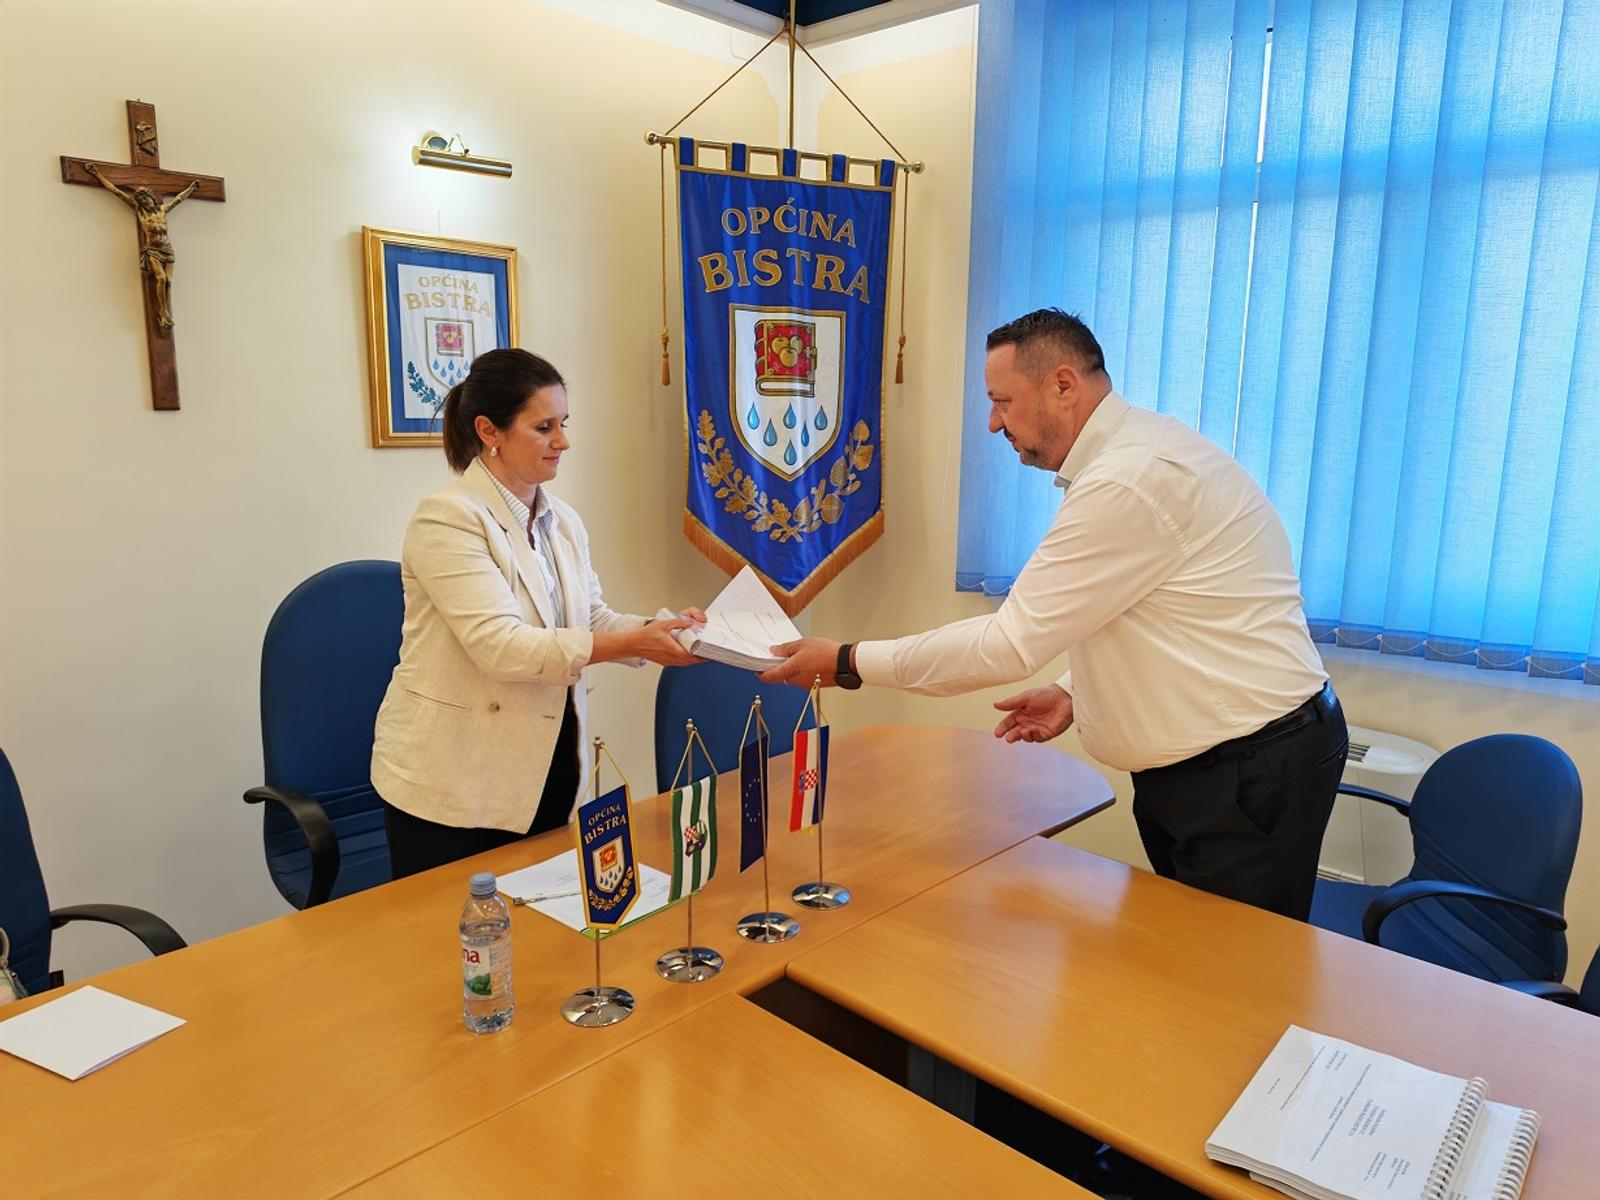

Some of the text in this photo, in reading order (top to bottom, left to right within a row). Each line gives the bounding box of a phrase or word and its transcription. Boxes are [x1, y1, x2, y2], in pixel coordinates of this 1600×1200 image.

[721, 197, 857, 248] OPĆINA
[419, 274, 480, 293] OPĆINA
[698, 248, 870, 305] BISTRA
[404, 292, 491, 317] BISTRA
[584, 814, 627, 845] BISTRA
